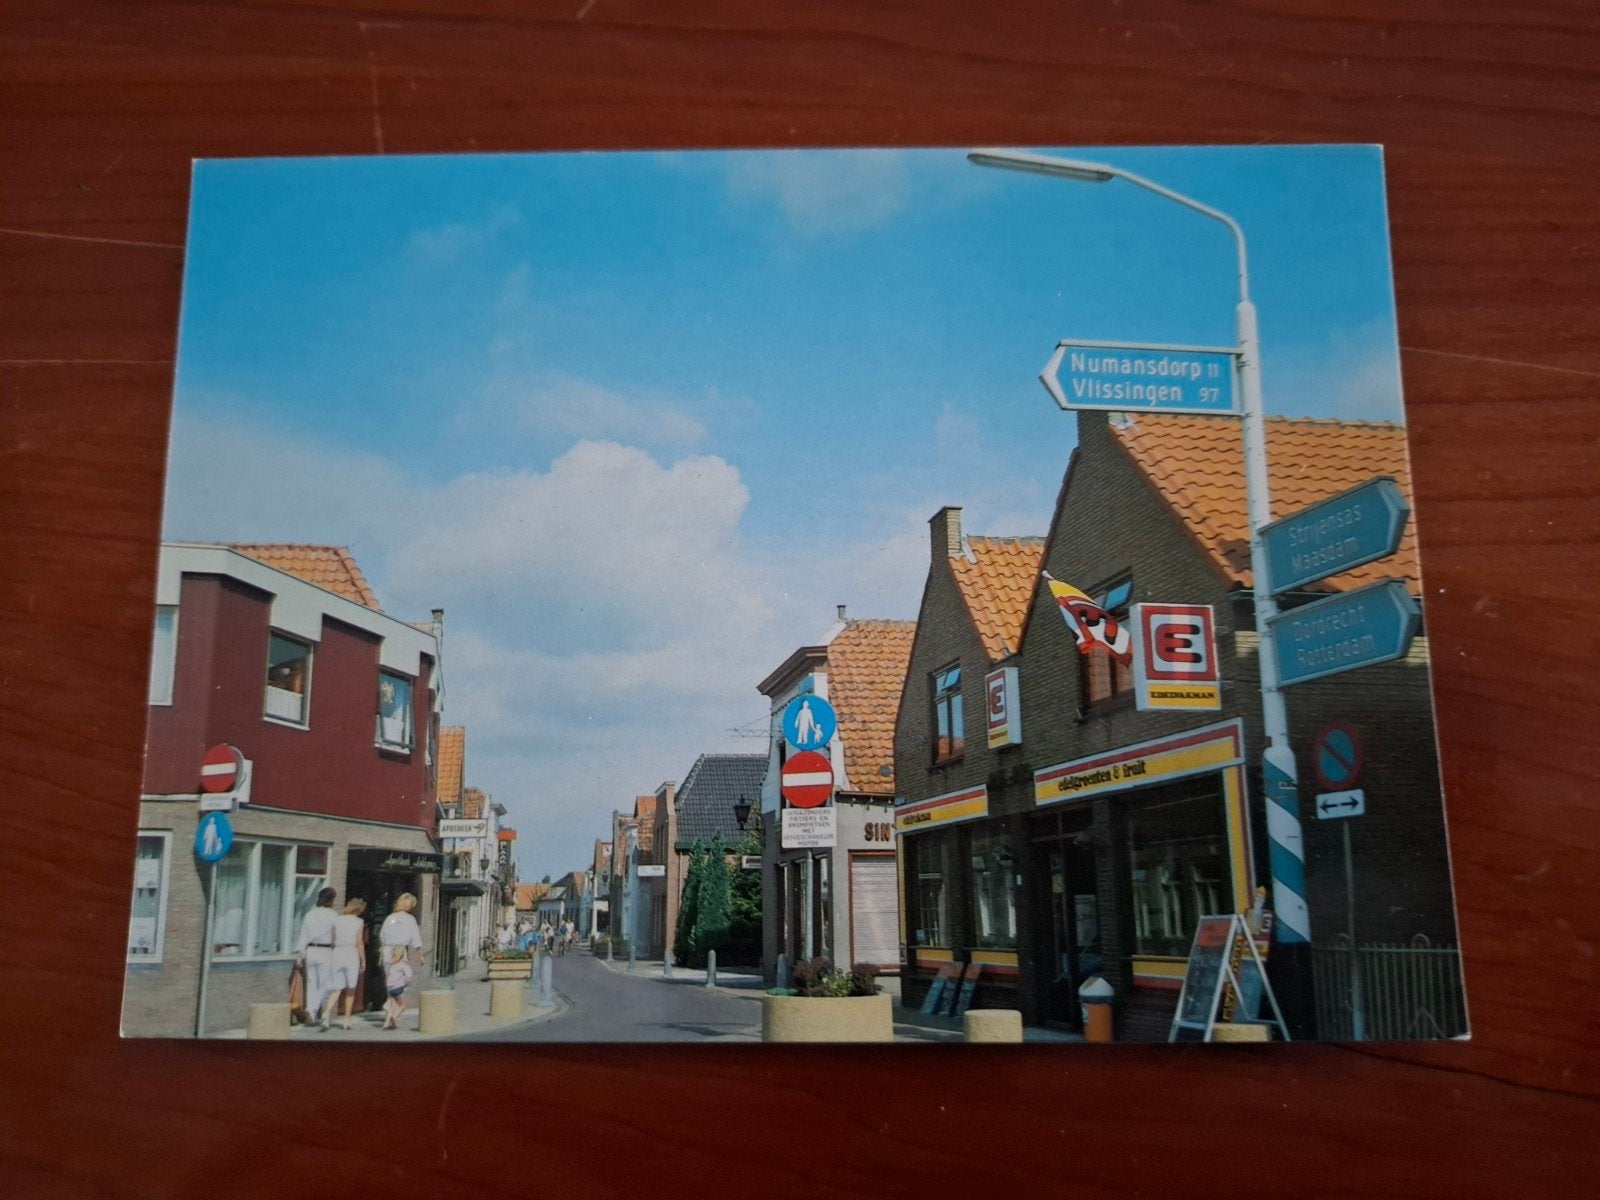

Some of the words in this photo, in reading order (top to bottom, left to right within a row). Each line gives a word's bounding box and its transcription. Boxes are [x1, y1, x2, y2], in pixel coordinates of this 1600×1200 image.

[1071, 353, 1200, 380] Numansdorp
[1073, 378, 1182, 406] Vlissingen
[1199, 388, 1219, 402] 97
[1293, 604, 1366, 642] Dordrecht
[1297, 634, 1375, 668] Rotterdam
[1122, 759, 1146, 779] fruit
